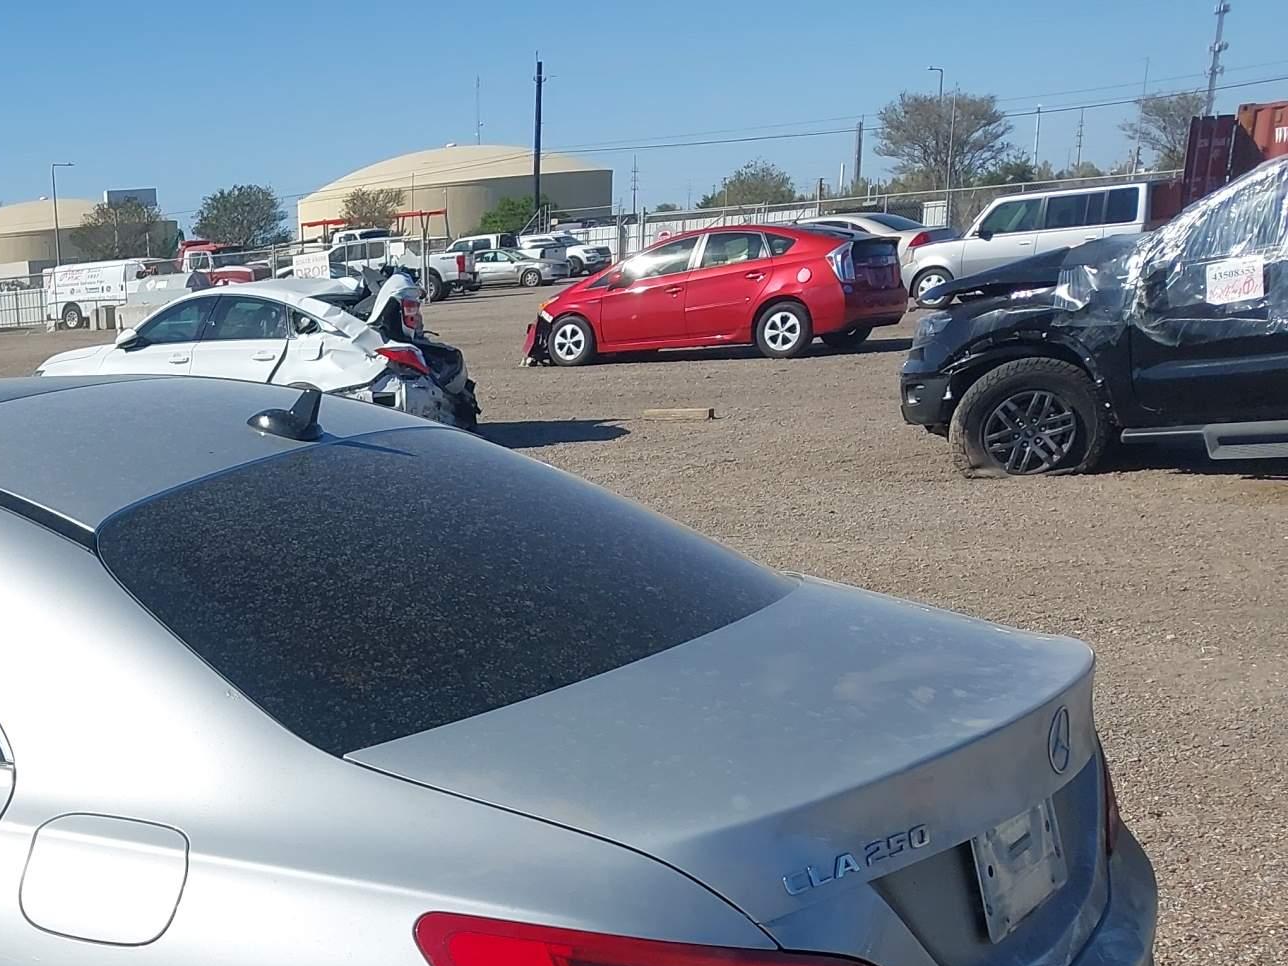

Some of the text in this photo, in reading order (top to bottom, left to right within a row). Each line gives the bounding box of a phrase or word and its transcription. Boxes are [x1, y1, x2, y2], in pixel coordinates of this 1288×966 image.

[295, 264, 328, 279] DROP
[782, 823, 931, 896] CLA 250
